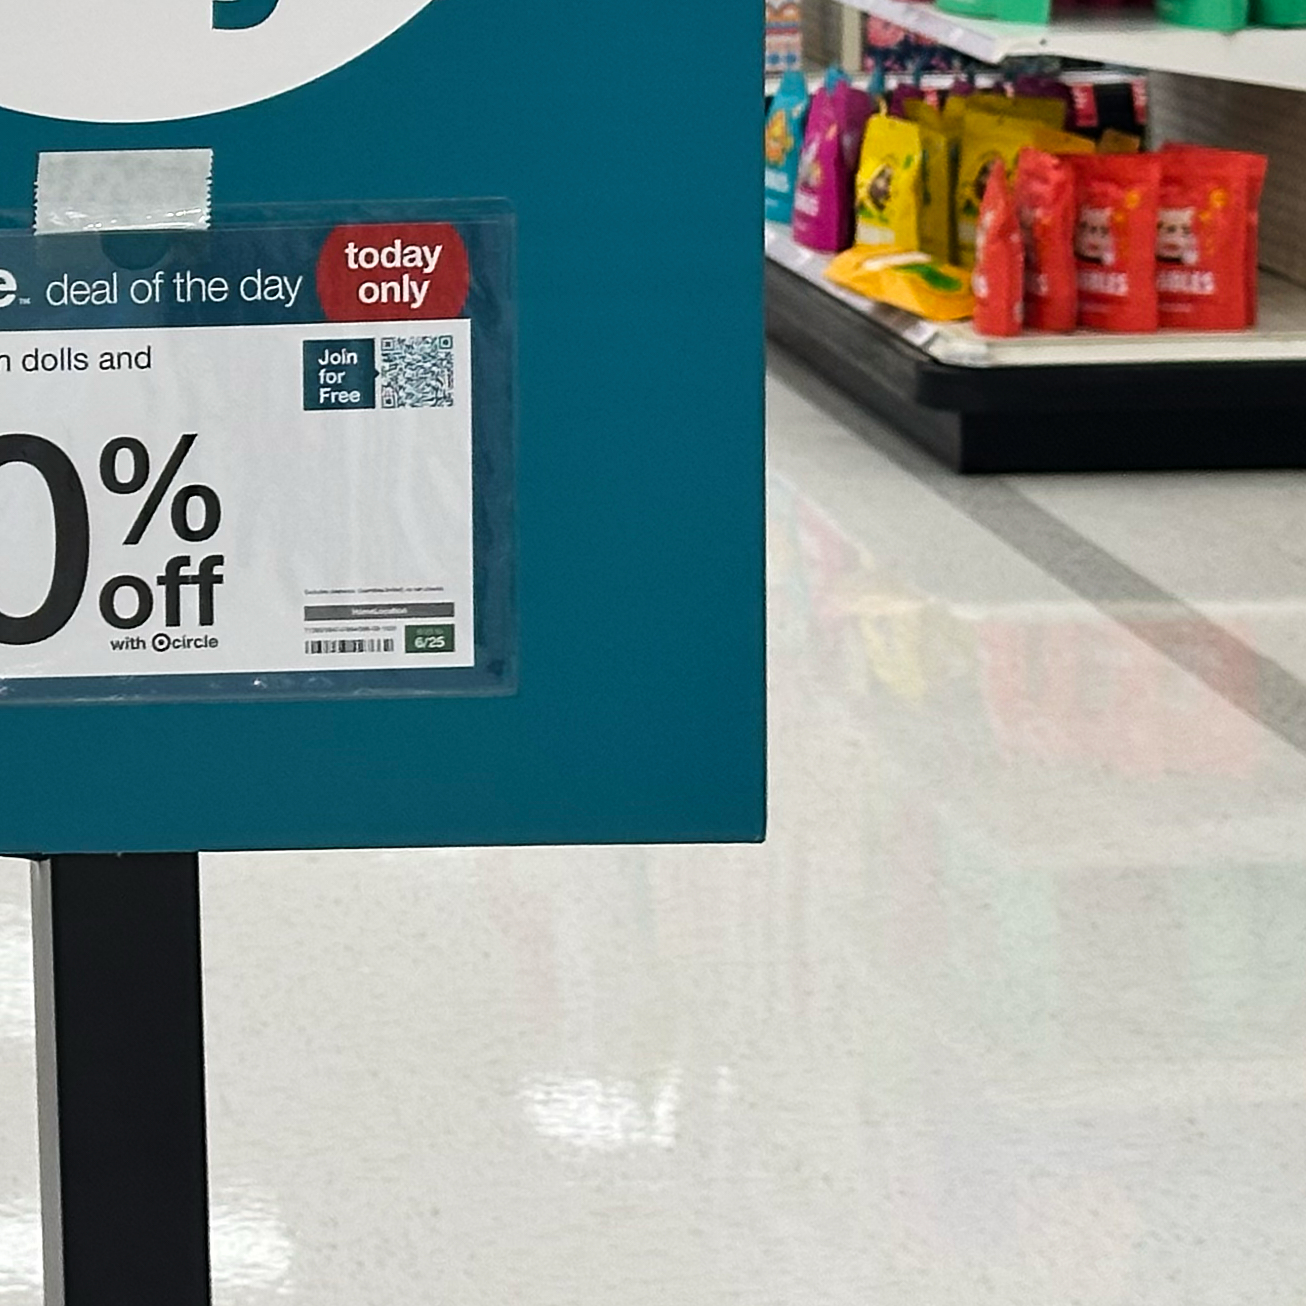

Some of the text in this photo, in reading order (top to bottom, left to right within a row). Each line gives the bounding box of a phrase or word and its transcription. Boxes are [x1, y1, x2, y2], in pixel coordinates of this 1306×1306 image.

[344, 238, 443, 274] today
[45, 268, 303, 308] deal of the day
[358, 273, 431, 309] only
[21, 347, 89, 372] dolls
[98, 345, 152, 370] and
[318, 348, 358, 366] Join
[318, 368, 346, 384] for
[319, 387, 361, 404] Free
[98, 554, 225, 630] off
[110, 634, 219, 651] with circle
[414, 635, 447, 649] 6/25
